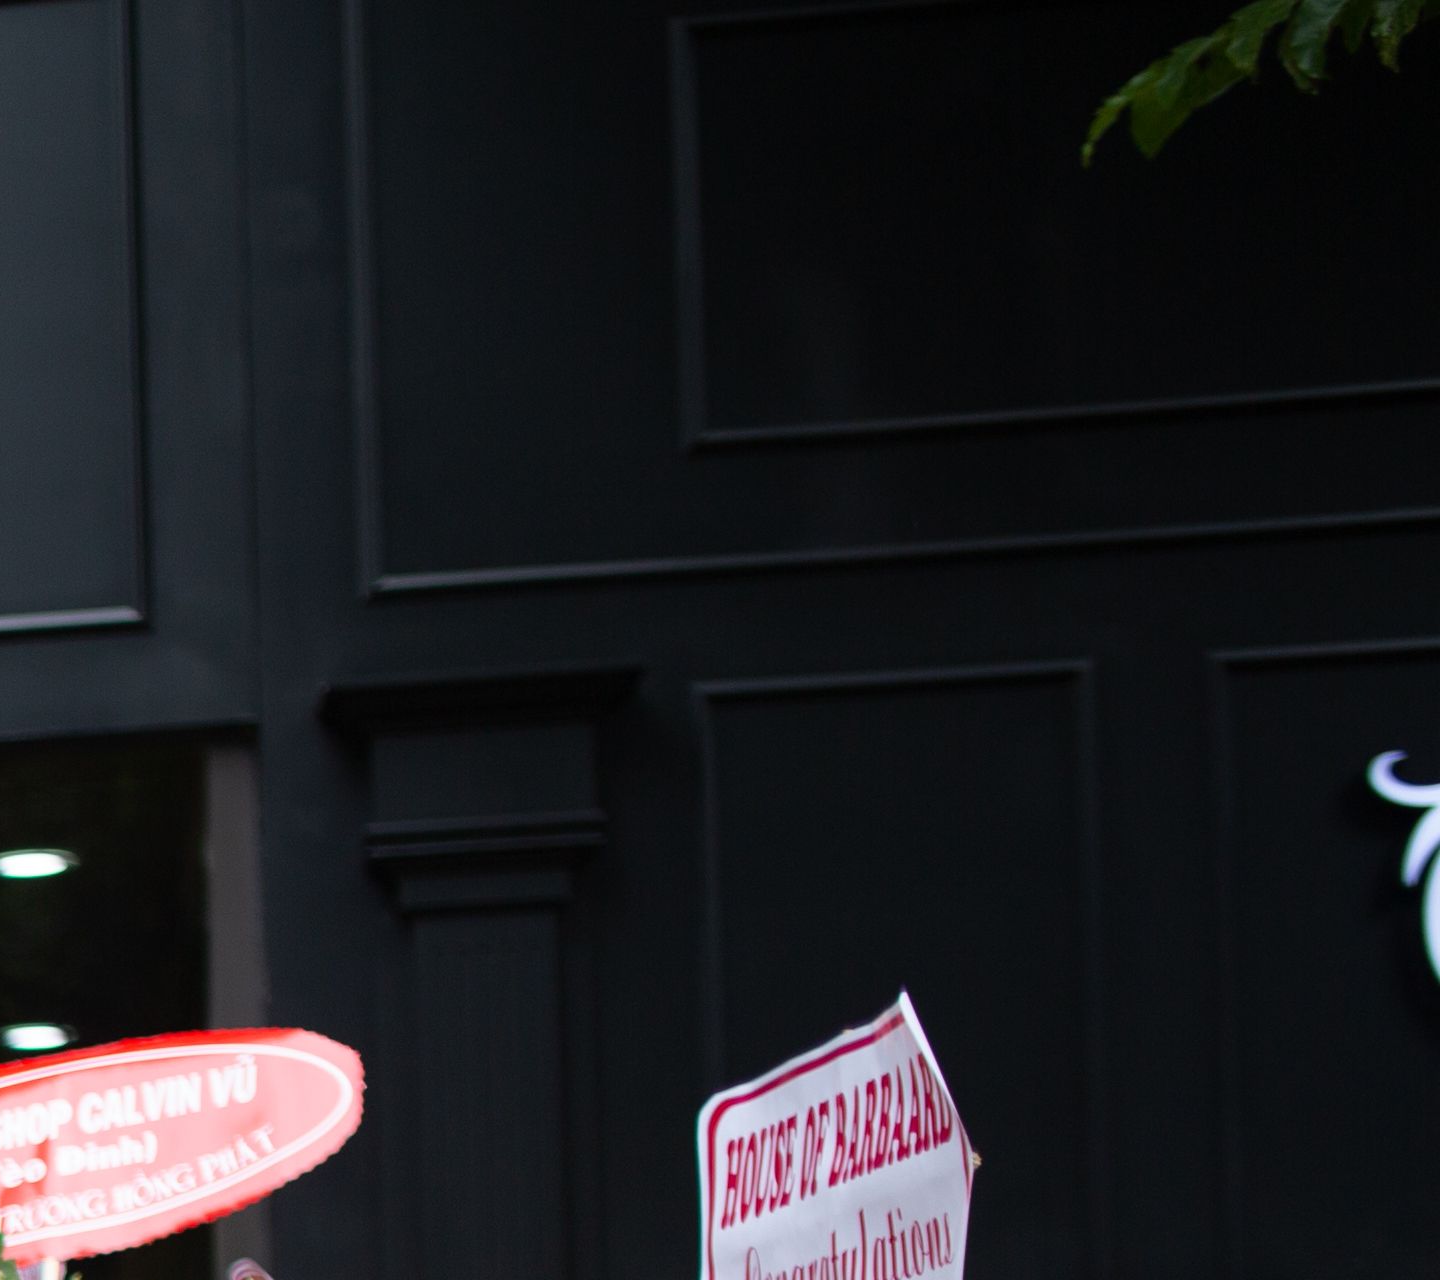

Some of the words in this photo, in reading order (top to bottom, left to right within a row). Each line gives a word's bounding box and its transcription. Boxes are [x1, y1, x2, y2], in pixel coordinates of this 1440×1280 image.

[77, 1073, 202, 1135] CALVIN
[721, 1113, 797, 1230] HOUSE
[800, 1100, 829, 1200] OF
